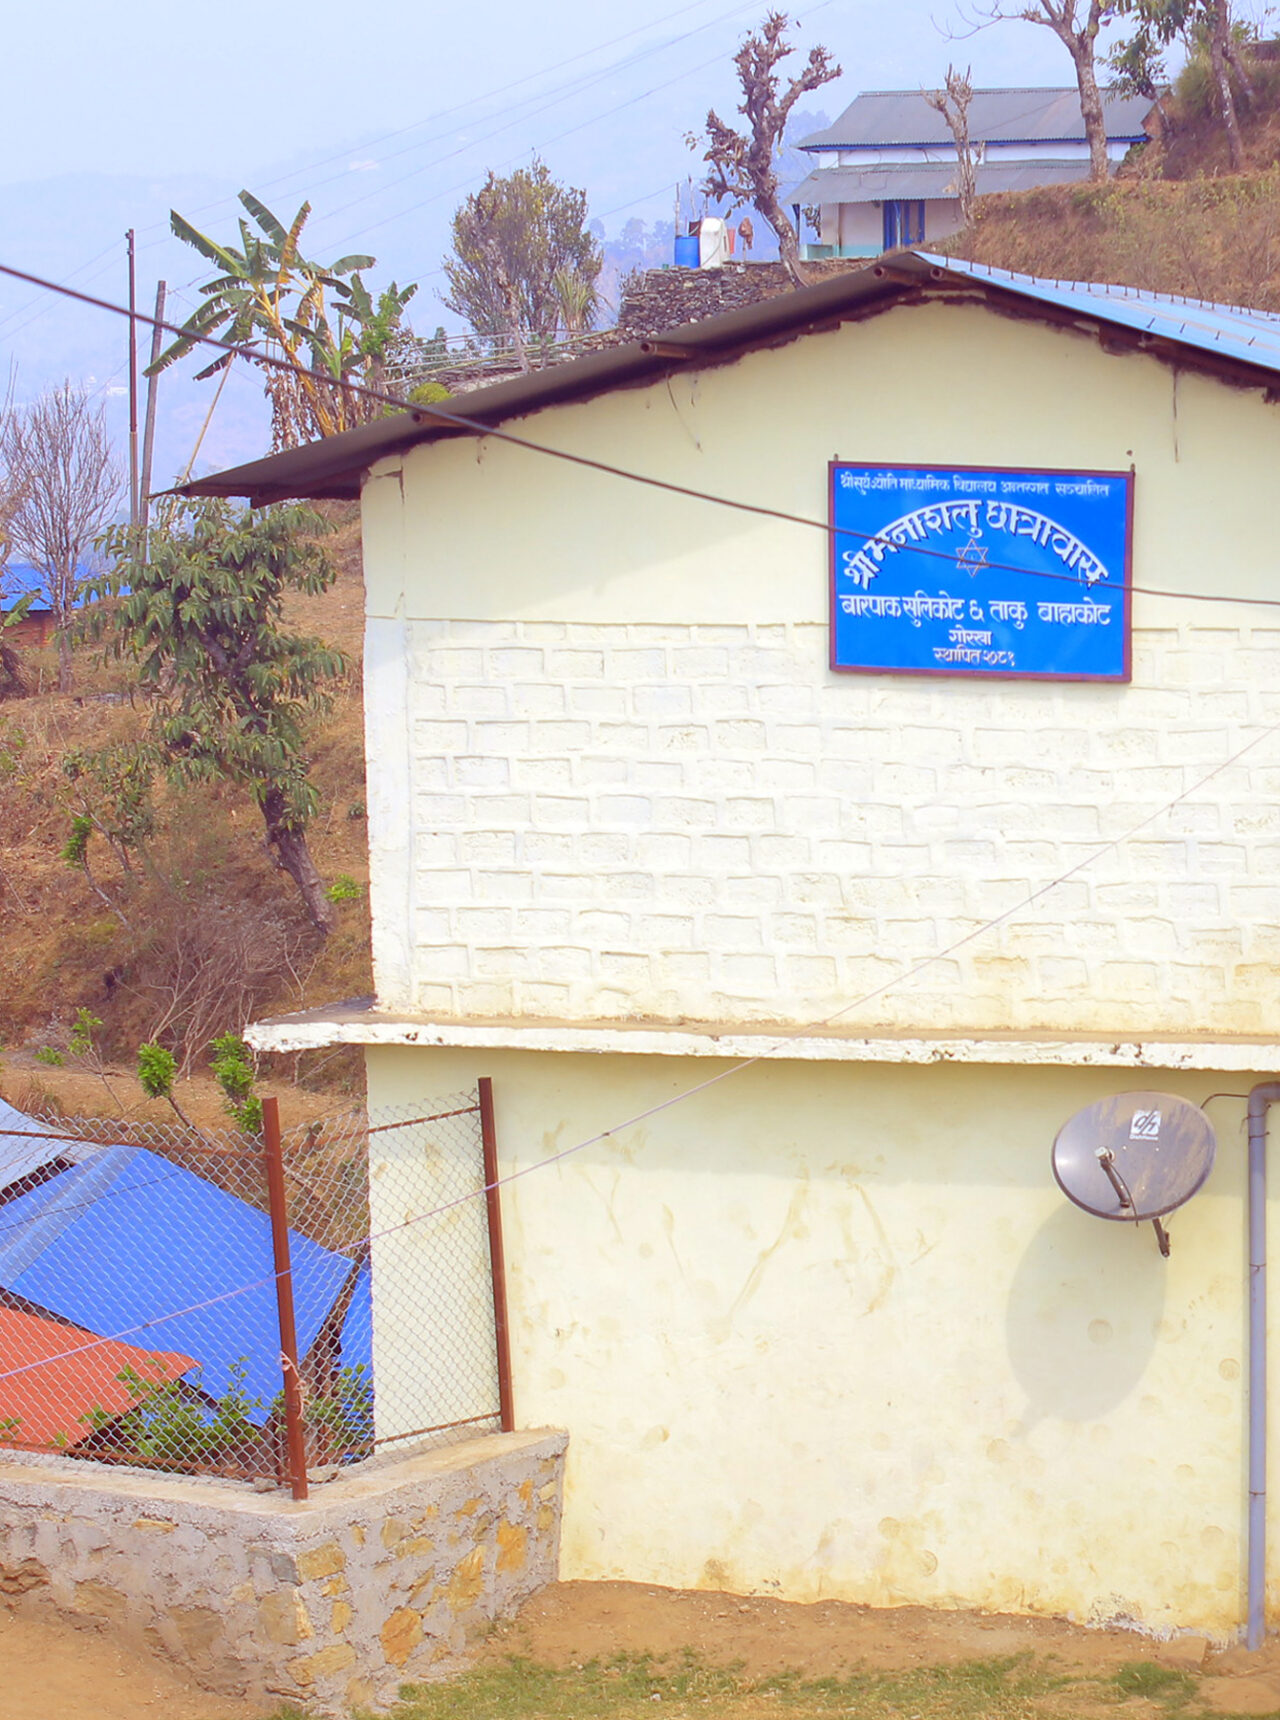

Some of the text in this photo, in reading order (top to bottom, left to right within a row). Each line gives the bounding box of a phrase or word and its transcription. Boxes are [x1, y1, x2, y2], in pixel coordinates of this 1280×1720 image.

[953, 475, 996, 493] विद्यालय
[986, 500, 1109, 589] छात्रावास
[839, 594, 902, 619] बारपाक
[902, 590, 965, 628] सुलिकोट
[988, 600, 1028, 630] ताकु
[948, 624, 992, 647] गोरखा
[932, 644, 981, 665] स्थापित
